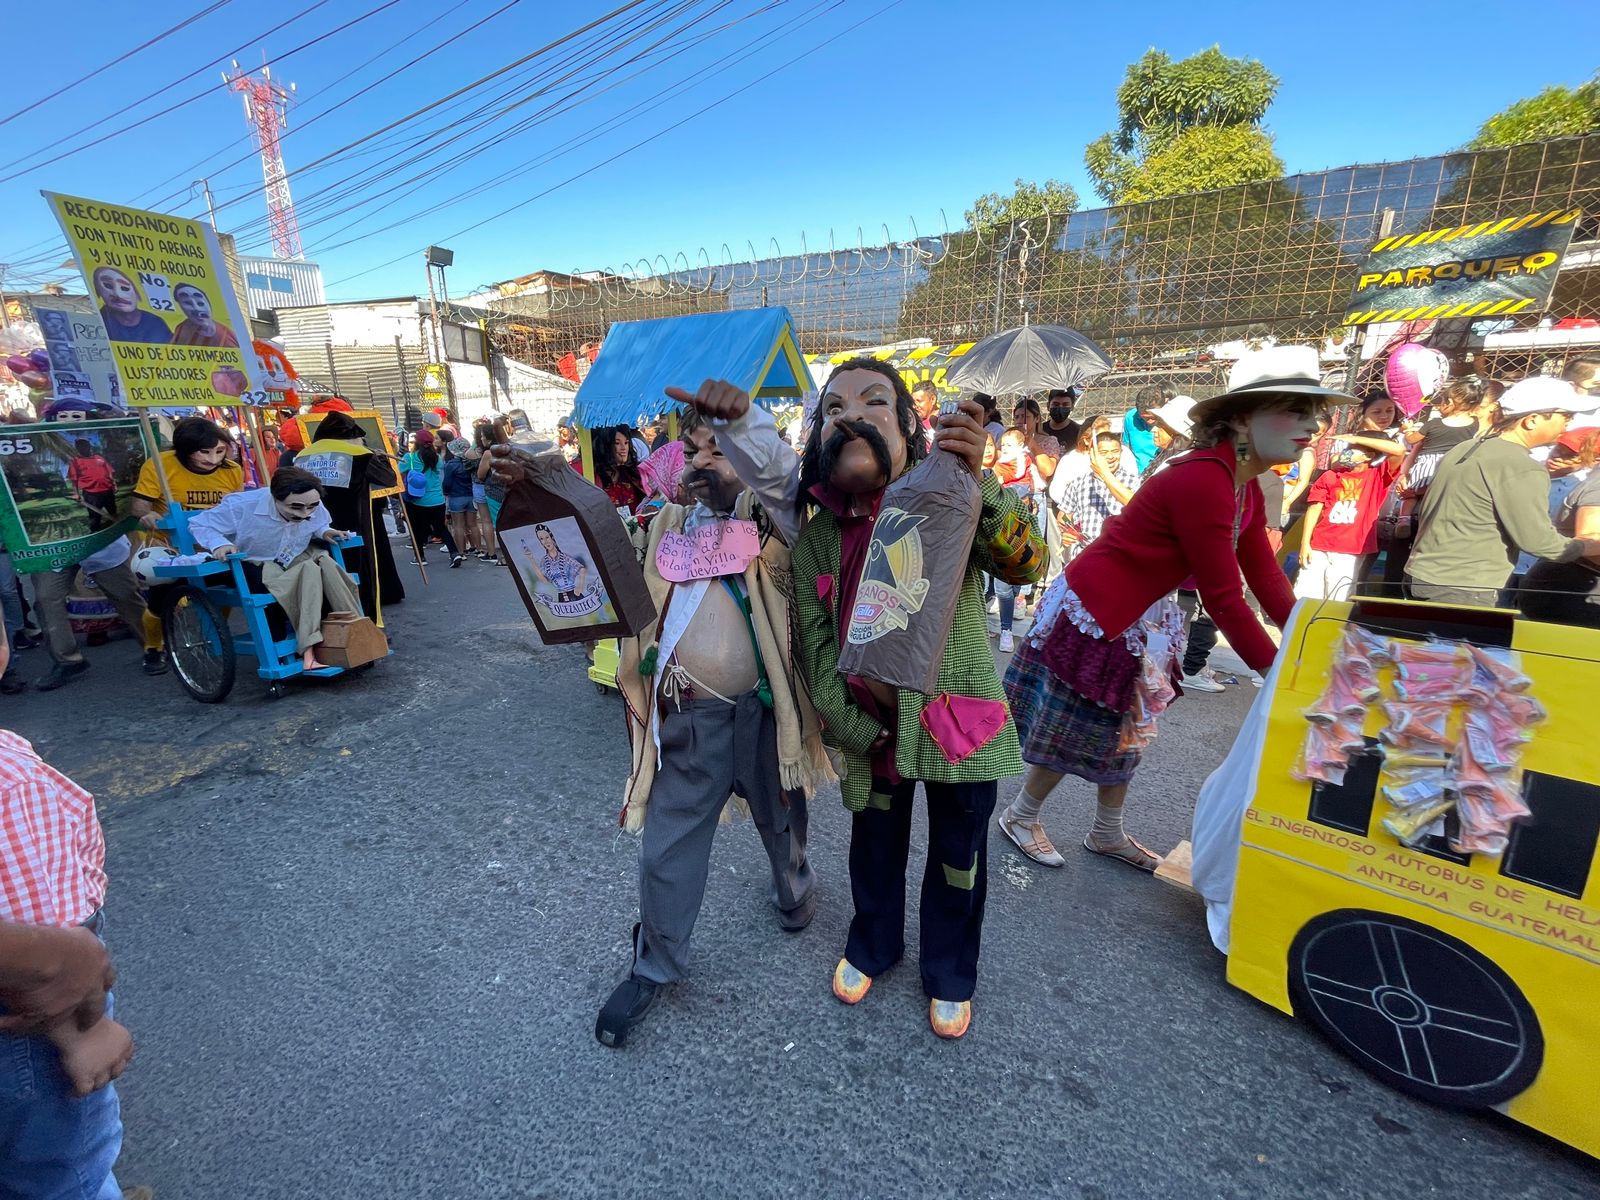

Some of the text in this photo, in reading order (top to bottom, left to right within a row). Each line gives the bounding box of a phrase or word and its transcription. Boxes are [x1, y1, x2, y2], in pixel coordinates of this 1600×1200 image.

[63, 201, 198, 239] RECORDANDO A
[73, 224, 205, 259] DON TINITO ARENAS
[105, 251, 122, 267] SU
[125, 254, 156, 272] HIJO
[160, 260, 206, 278] AROLDO
[1356, 252, 1559, 292] PARQUEO
[150, 298, 175, 312] 32
[117, 345, 239, 363] UNO DE LOS PRIMEROS
[124, 366, 208, 381] LUSTRADORES
[130, 387, 215, 400] DE VILLA NUEVA
[241, 391, 269, 406] 32
[726, 526, 735, 534] a
[740, 522, 758, 537] los
[13, 545, 68, 561] Mechito
[701, 541, 721, 554] de
[705, 552, 736, 566] Villa
[553, 596, 597, 615] QUEZALTECA
[863, 585, 898, 609] AÑOS
[1245, 808, 1264, 823] EL
[1269, 815, 1377, 856] INGENIOSO
[1384, 852, 1485, 891] AUTOBUS
[1494, 884, 1529, 905] DE
[1356, 864, 1600, 952] ANTIGUA GUATEMAL
